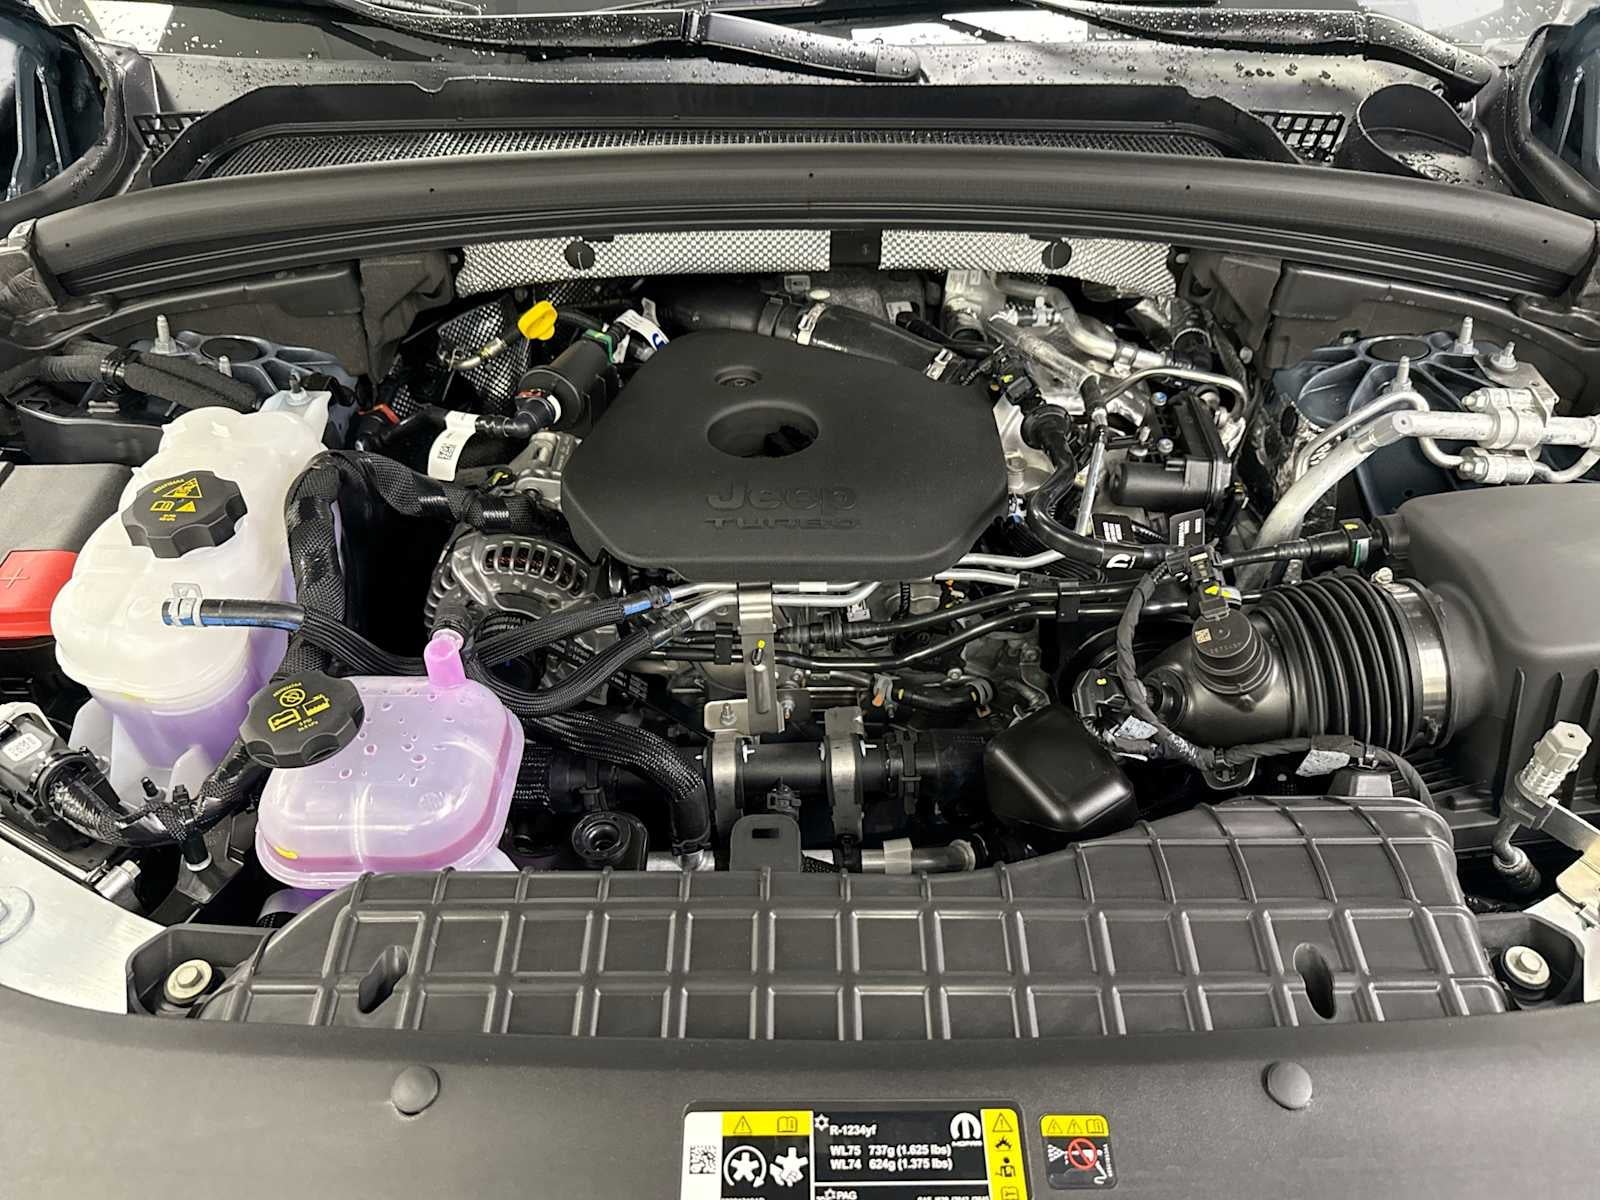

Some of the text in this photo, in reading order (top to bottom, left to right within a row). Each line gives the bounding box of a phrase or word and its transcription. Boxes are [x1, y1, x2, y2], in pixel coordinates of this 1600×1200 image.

[705, 482, 858, 515] Jeep
[704, 517, 862, 530] TURBO
[829, 1123, 878, 1138] R-1234yf
[829, 1143, 952, 1157] WL75 737g (1.625 lbs)
[829, 1157, 953, 1171] WL74 624g (1.375 lbs)
[835, 1190, 858, 1200] PAG
